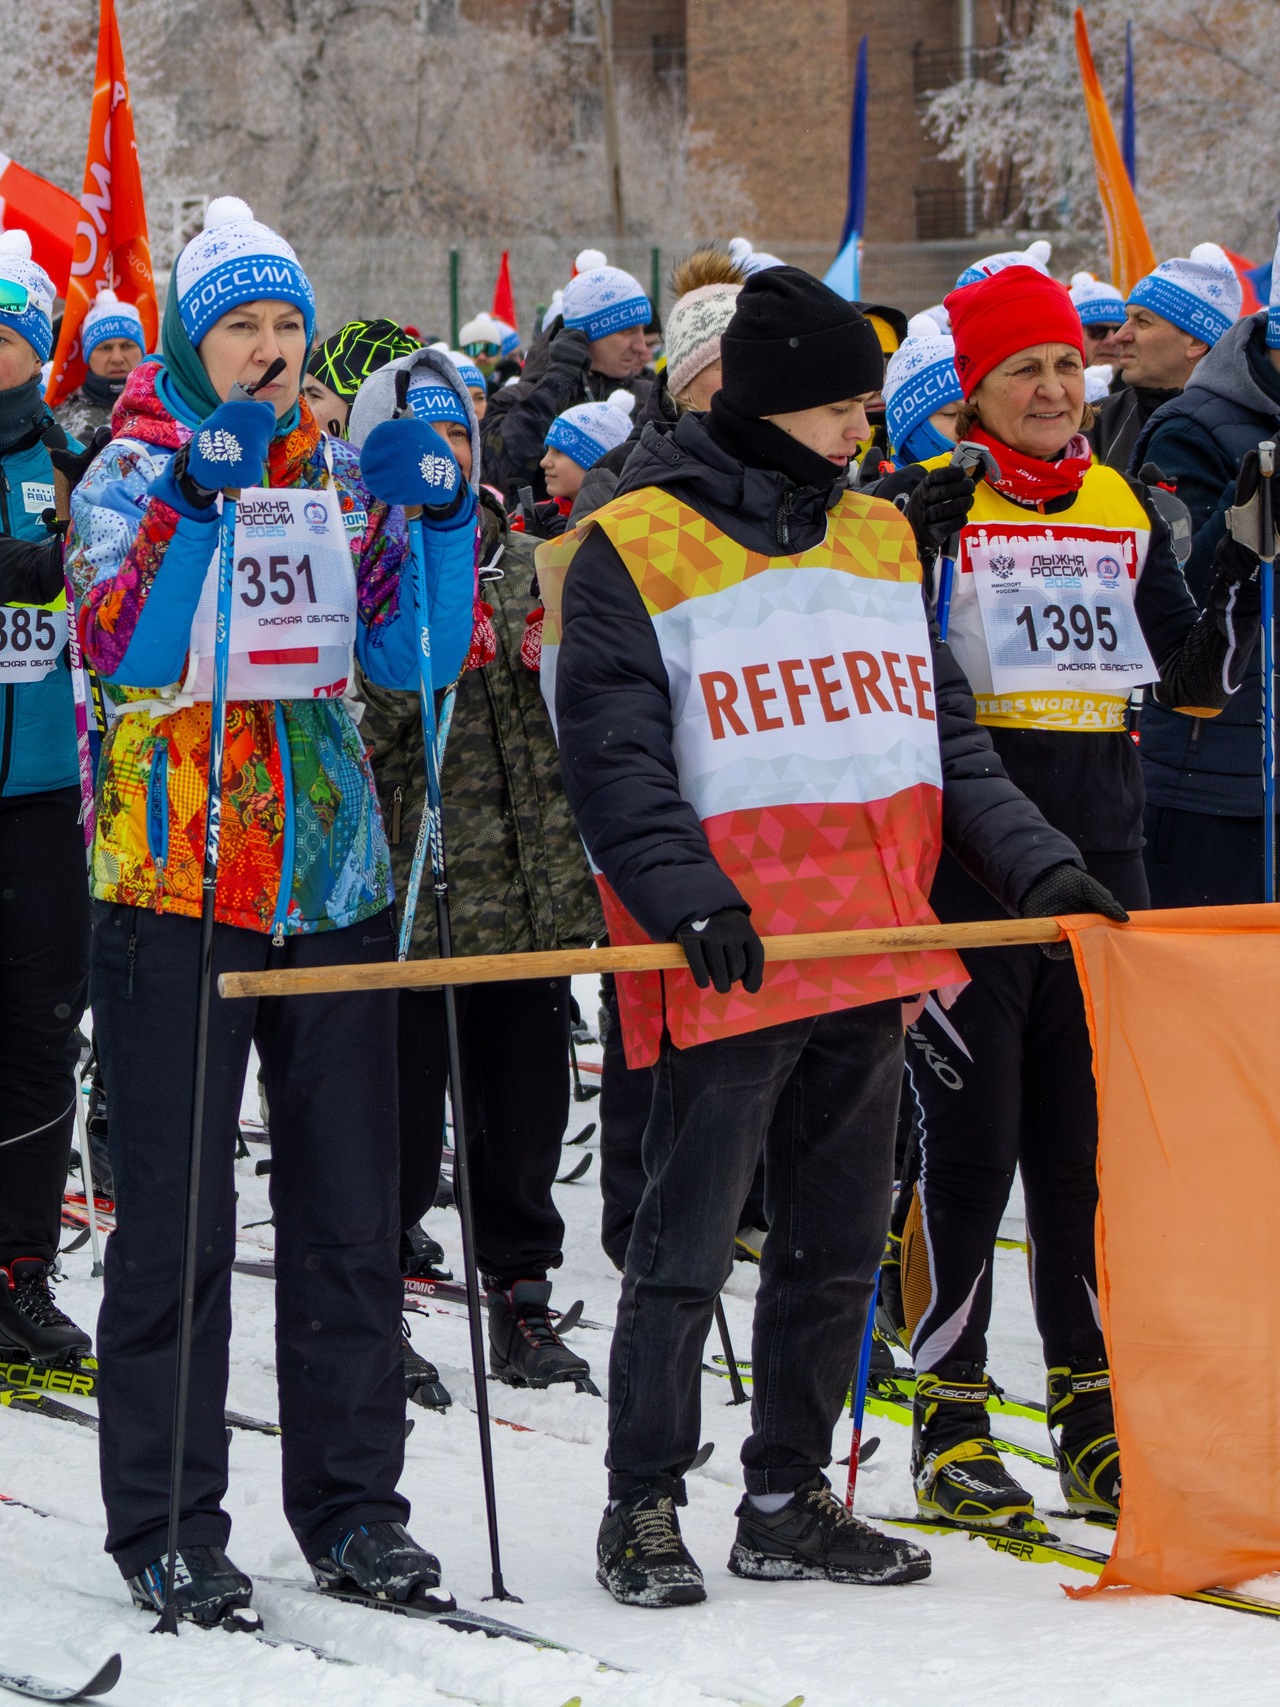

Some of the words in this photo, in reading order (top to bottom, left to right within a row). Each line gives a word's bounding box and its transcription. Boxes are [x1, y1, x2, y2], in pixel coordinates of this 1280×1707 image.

[189, 265, 293, 319] РОССИИ
[590, 305, 648, 332] РОССИИ
[246, 525, 287, 538] 2025
[1032, 554, 1085, 566] ЛЫЖНЯ
[1030, 565, 1089, 578] РОССИИ
[237, 554, 318, 607] 351
[991, 581, 1022, 589] МИНСПОРТ
[1044, 577, 1082, 589] 2025
[258, 617, 303, 627] ОМСКАЯ
[307, 614, 350, 624] ОБЛАСТЬ
[1016, 604, 1118, 651] 1395
[1057, 662, 1097, 672] ОМСКАЯ
[1100, 662, 1143, 672] ОБЛАСТЬ
[698, 650, 936, 740] REFEREE
[1030, 684, 1095, 712] WORLD
